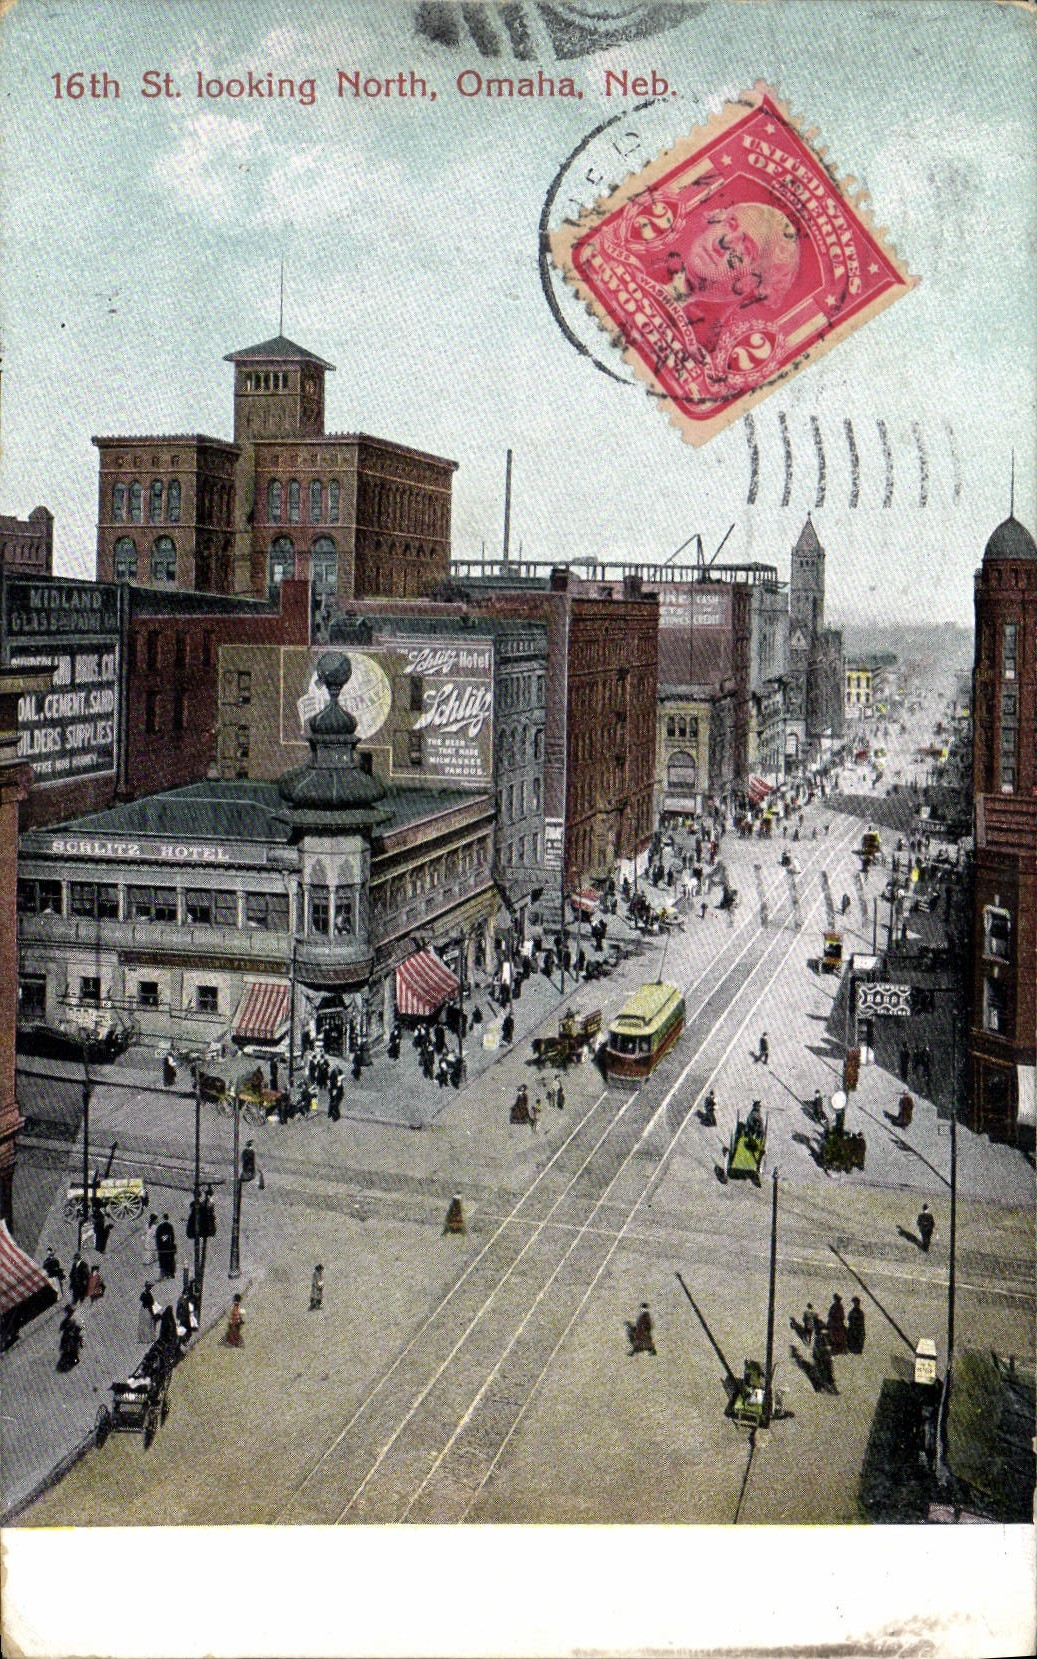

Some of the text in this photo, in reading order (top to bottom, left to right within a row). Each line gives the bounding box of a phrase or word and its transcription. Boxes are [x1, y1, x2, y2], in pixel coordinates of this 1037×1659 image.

[632, 200, 675, 241] 2
[741, 133, 827, 199] UNITED
[822, 196, 862, 295] STATES
[747, 152, 783, 178] OF
[778, 174, 846, 281] AMERICA
[588, 250, 637, 312] TWO
[610, 261, 702, 380] POSTAGE
[640, 275, 696, 347] WASHINGTON
[730, 331, 774, 373] 2
[30, 588, 101, 609] MIDLAND
[11, 611, 58, 631] GLASS
[403, 648, 458, 675] Schlitz
[460, 651, 490, 669] Hotel
[412, 683, 493, 738] Schlitz
[65, 720, 112, 749] SUPPLIES
[429, 756, 481, 766] MILWAUKEE
[52, 840, 230, 861] SCHLITZ HOTEL
